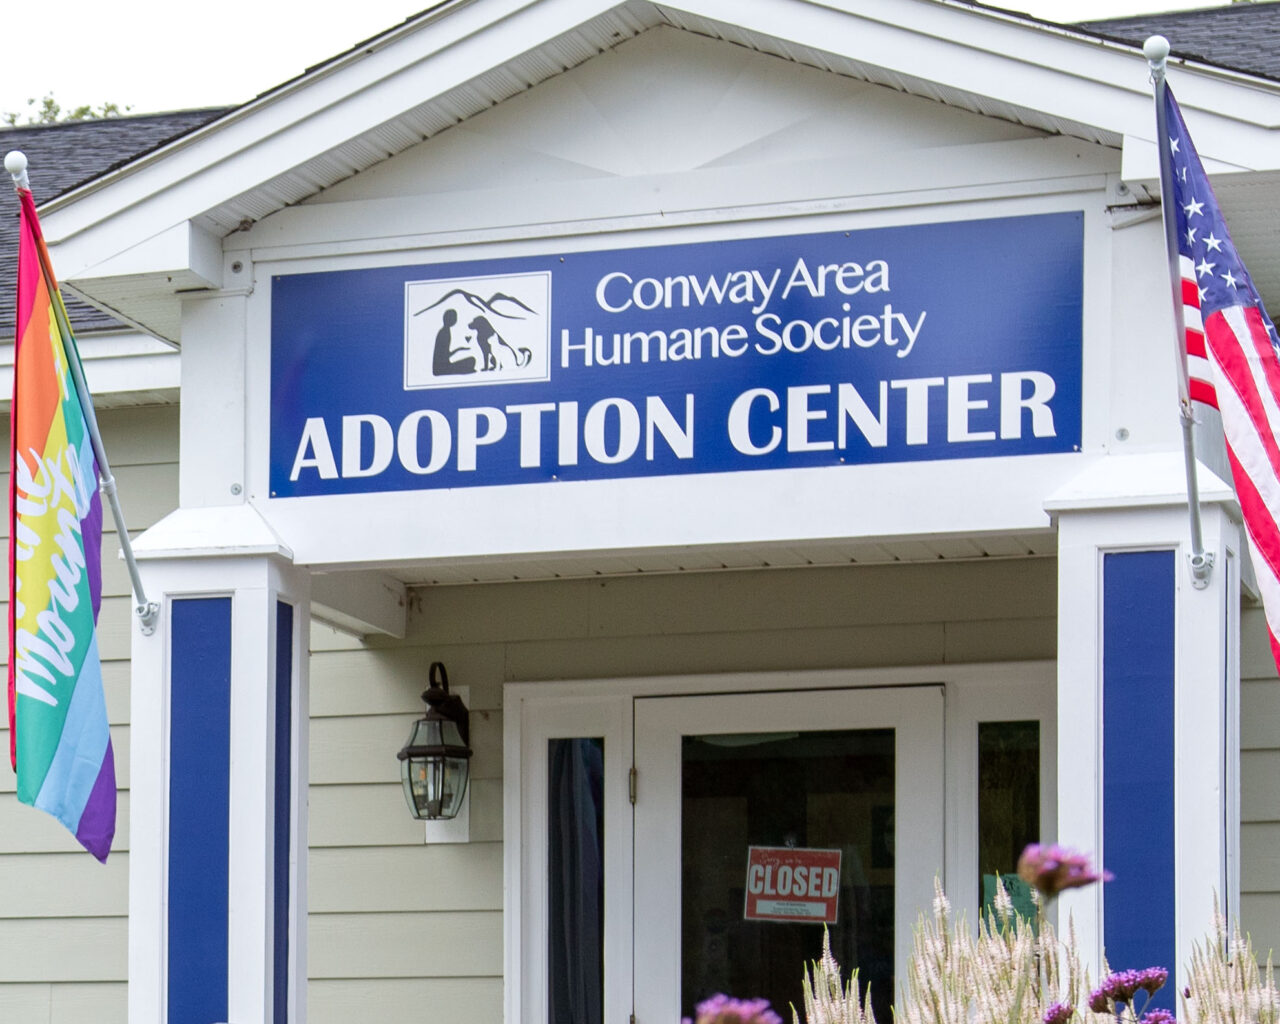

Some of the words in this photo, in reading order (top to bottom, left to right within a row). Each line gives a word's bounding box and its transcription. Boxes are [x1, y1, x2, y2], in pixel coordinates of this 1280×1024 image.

[595, 267, 782, 316] Conway
[781, 256, 891, 300] Area
[559, 325, 749, 369] Humane
[754, 301, 928, 359] Society
[289, 393, 695, 482] ADOPTION
[727, 370, 1057, 456] CENTER
[748, 863, 839, 898] CLOSED
